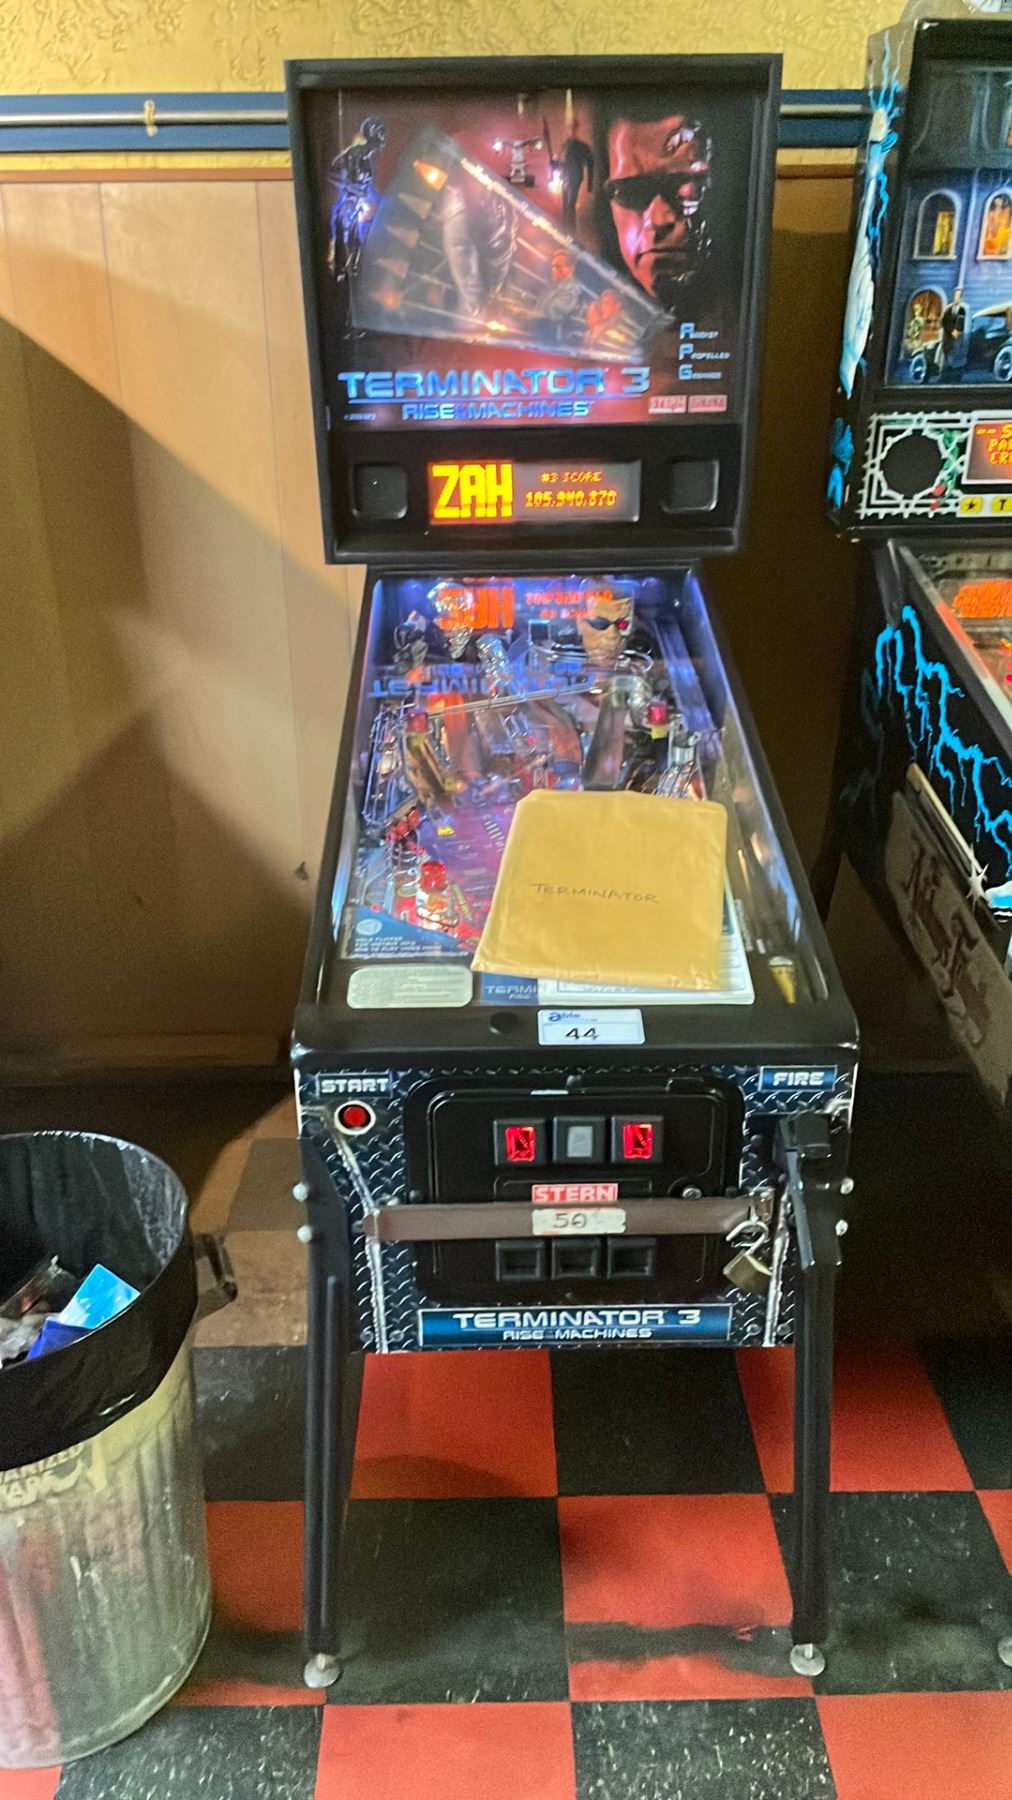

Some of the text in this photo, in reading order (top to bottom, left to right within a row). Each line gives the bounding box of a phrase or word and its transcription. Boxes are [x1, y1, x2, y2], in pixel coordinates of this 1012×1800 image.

[337, 368, 605, 398] TERMINATOR
[620, 366, 651, 394] 3
[402, 402, 455, 420] RISE
[468, 400, 590, 419] MACHINES
[432, 464, 513, 519] ZAH
[529, 883, 659, 904] TERMINATOR
[564, 1027, 600, 1041] 44
[321, 1078, 389, 1094] START
[772, 1071, 825, 1086] FIRE
[534, 1184, 615, 1203] STERN
[452, 1309, 701, 1329] TERMINATOR 3
[502, 1327, 653, 1341] RISE MACHINES
